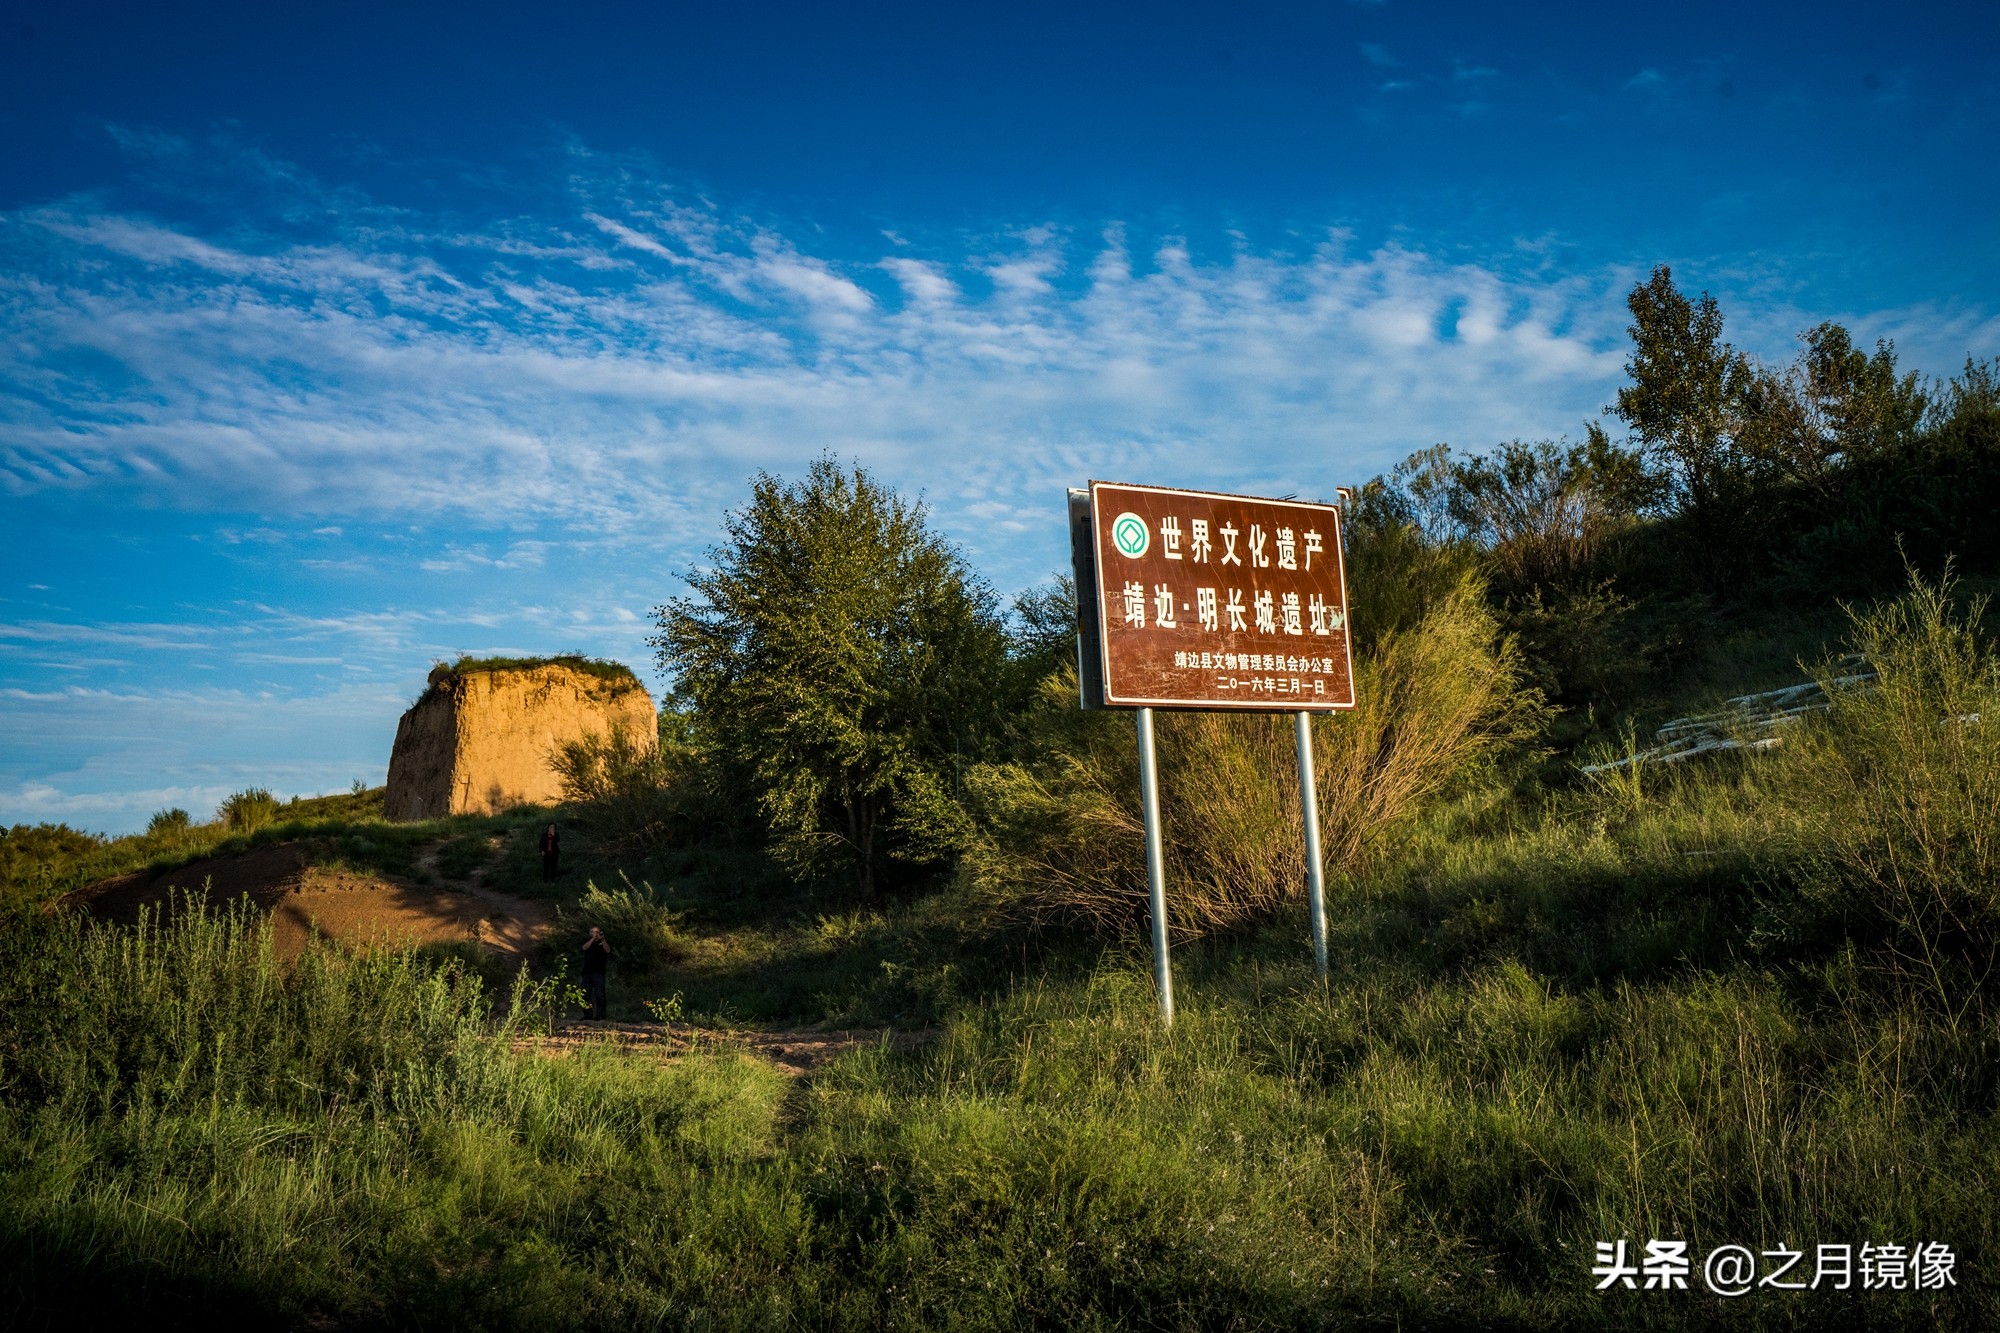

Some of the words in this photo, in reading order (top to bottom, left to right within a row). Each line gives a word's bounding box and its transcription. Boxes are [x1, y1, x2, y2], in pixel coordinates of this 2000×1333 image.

[1160, 516, 1323, 572] 世界文化遗产
[1174, 651, 1334, 674] 靖边县文物管理委员会办公室
